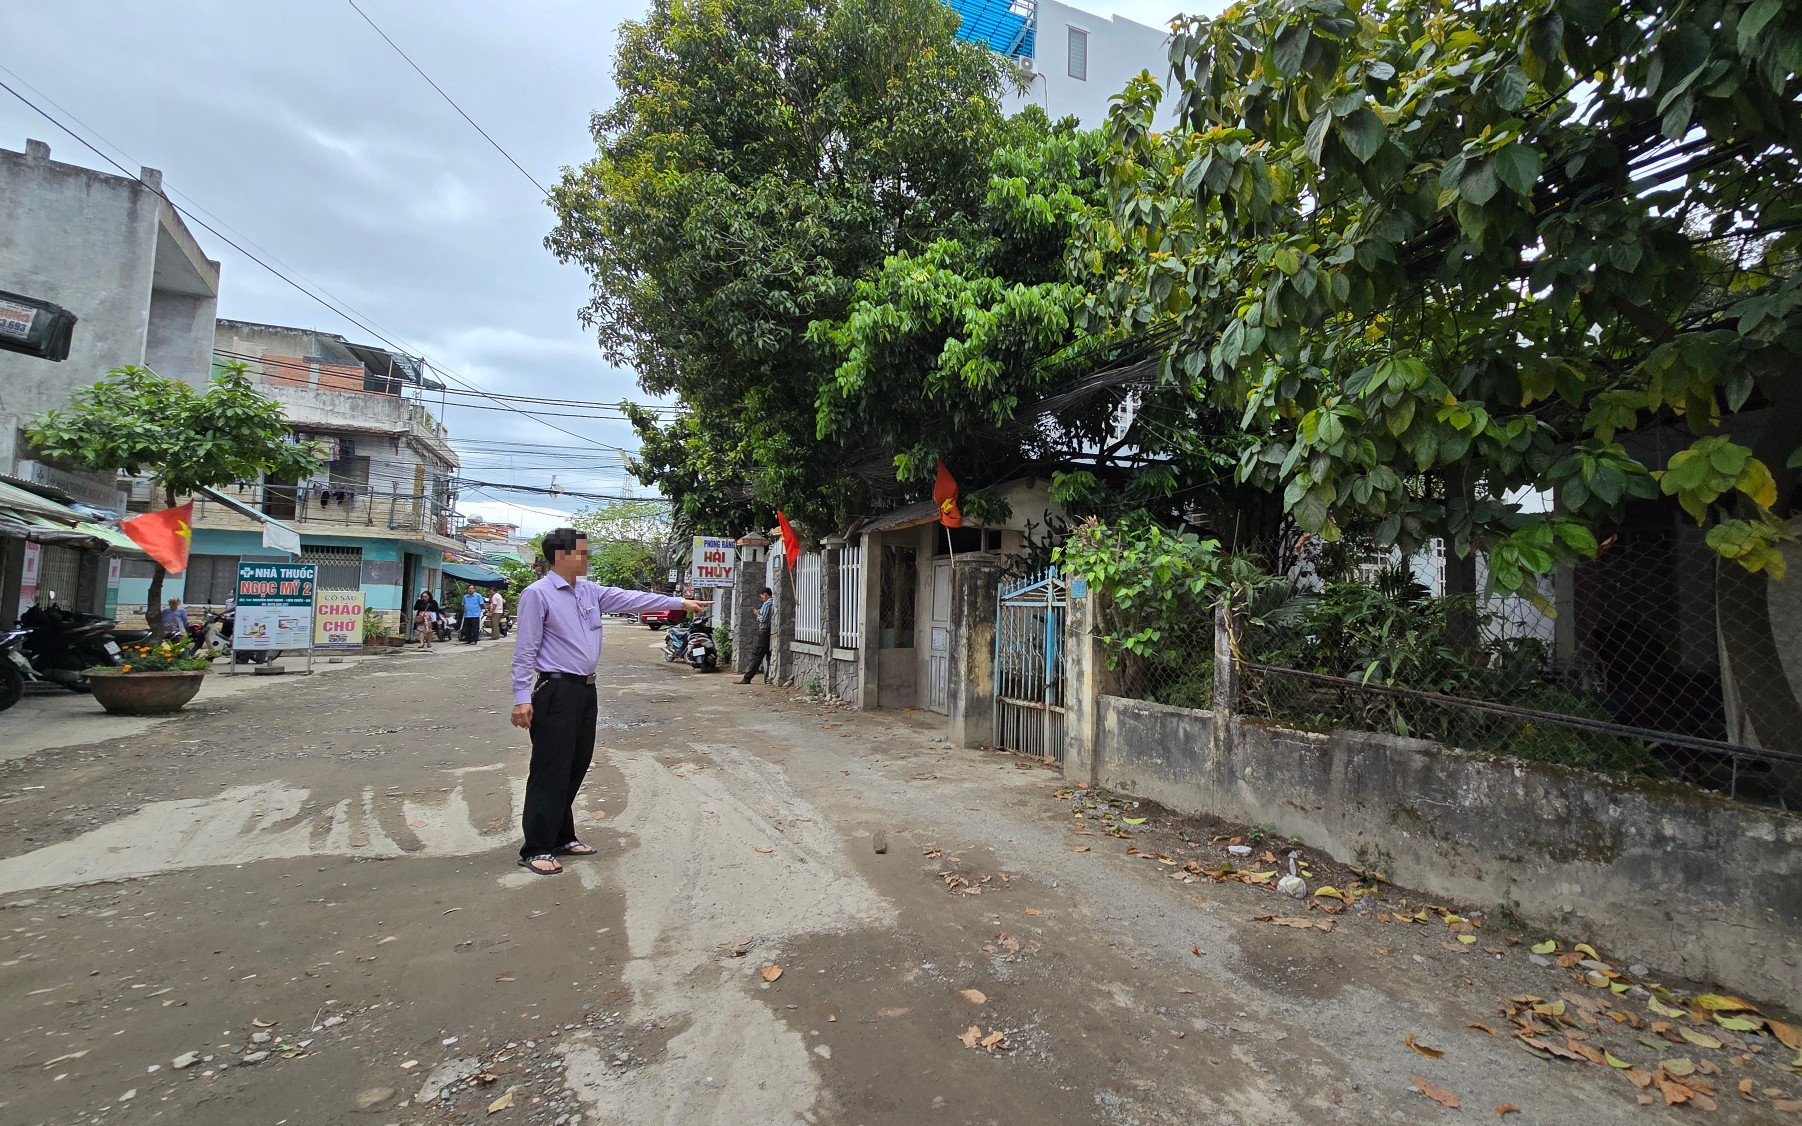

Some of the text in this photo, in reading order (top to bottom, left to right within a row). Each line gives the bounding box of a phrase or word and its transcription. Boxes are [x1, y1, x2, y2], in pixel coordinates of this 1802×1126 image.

[704, 548, 726, 564] HẢI
[255, 566, 314, 579] NHÀ THUỐC
[240, 579, 312, 598] NGỌC MỸ 2
[318, 602, 362, 616] CHÁO
[322, 618, 356, 632] CHỜ
